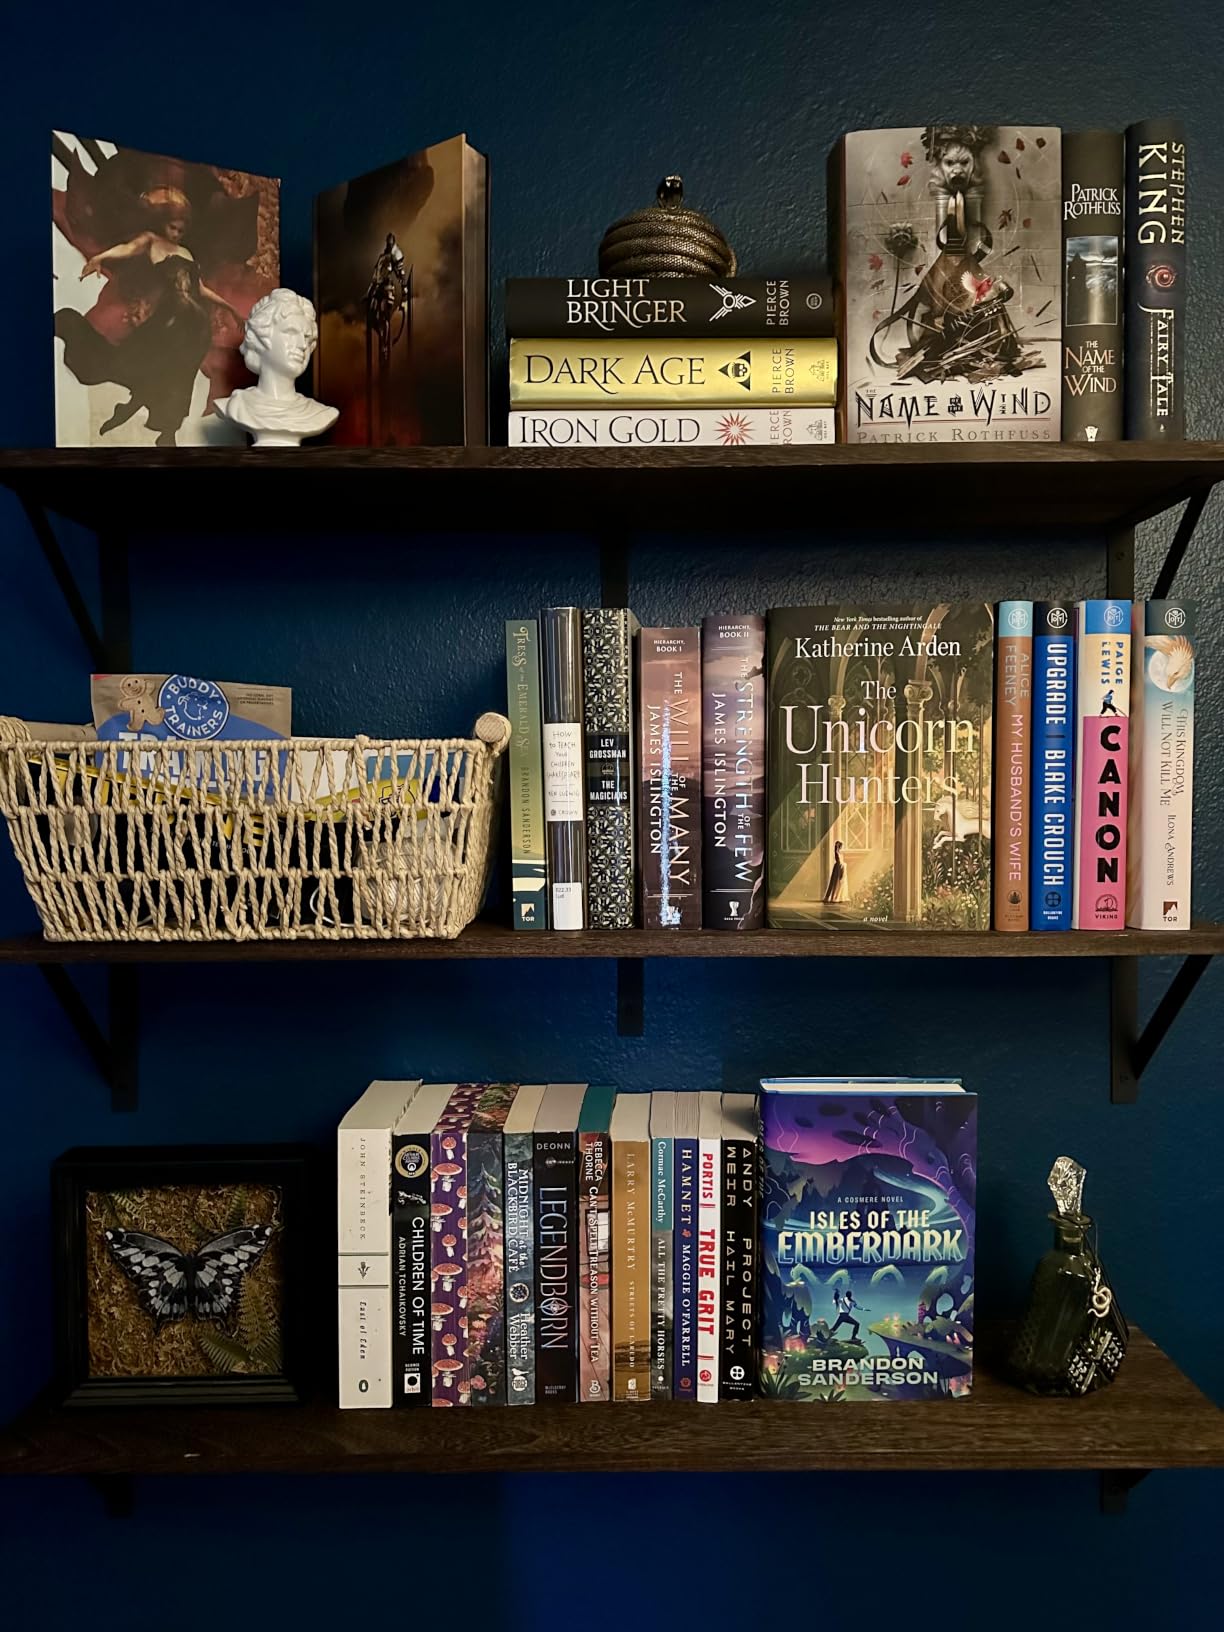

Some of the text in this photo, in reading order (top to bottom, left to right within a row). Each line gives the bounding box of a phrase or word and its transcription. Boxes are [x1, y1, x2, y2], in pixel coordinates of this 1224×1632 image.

[1063, 201, 1121, 220] ROTHFUSS
[1071, 183, 1118, 202] PATRICK
[1138, 142, 1167, 244] KING
[1169, 141, 1185, 245] STEPHEN
[567, 278, 650, 298] LIGHT
[766, 280, 777, 325] PIERCE
[779, 280, 790, 326] BROWN
[566, 300, 687, 331] BRINGER
[1065, 346, 1116, 369] NAME
[1086, 340, 1099, 348] THE
[1137, 302, 1174, 416] FAIRY TALE
[526, 354, 706, 395] DARK AGE
[772, 348, 782, 393] PIERCE
[785, 348, 795, 394] BROWN
[1064, 374, 1117, 397] WIND
[855, 391, 940, 430] NAME
[969, 387, 1051, 426] WIND
[519, 415, 700, 447] IRON GOLD
[857, 428, 1051, 443] PATRICK ROTHFUSS
[719, 631, 740, 639] BOOK
[873, 615, 899, 623] bestselling
[889, 622, 942, 630] NIGHTINGALE
[740, 657, 749, 679] THE
[795, 635, 962, 658] Katherine Arden
[1101, 641, 1110, 685] LEWIS
[1115, 641, 1124, 685] PAIGE
[168, 676, 220, 699] BUDDY
[674, 671, 683, 694] THE
[860, 680, 897, 700] The
[1005, 645, 1017, 707] FEENEY
[1020, 653, 1031, 698] ALICE
[1045, 643, 1068, 725] UPGRADE
[165, 706, 224, 737] TRAINERS
[517, 684, 529, 734] EMERALD
[780, 705, 978, 754] Unicorn
[589, 749, 627, 759] GROSSMAN
[601, 738, 614, 747] LEV
[735, 681, 754, 808] STRENGTH
[1160, 701, 1173, 806] WILL NOT KILL ME
[601, 780, 615, 789] THE
[647, 704, 662, 854] JAMES ISLINGTON
[671, 772, 679, 791] THE
[679, 775, 686, 789] OF
[712, 692, 727, 847] JAMES ISLINGTON
[796, 763, 960, 805] Hunters
[1044, 749, 1066, 804] BLAKE
[520, 767, 532, 854] BRANDON SANDERSON
[590, 791, 628, 800] MAGICIANS
[1009, 714, 1024, 881] MY HUSBAND'S WIFE
[1095, 725, 1122, 883] CANON
[668, 796, 690, 886] MANY
[744, 815, 751, 827] OF
[734, 834, 753, 883] FEW
[1043, 813, 1065, 886] CROUCH
[1164, 814, 1177, 886] ILONA ANDREWS
[536, 1142, 571, 1151] DEONN
[585, 1142, 594, 1181] THORNE
[594, 1141, 603, 1182] REBECCA
[507, 1162, 518, 1236] BLACKBIRD
[518, 1169, 529, 1238] MIDNIGHT
[655, 1141, 667, 1223] Cormac McCarthy
[881, 1195, 904, 1203] NOVEL
[626, 1153, 636, 1270] LARRY McMURTRY
[809, 1209, 931, 1230] ISLES OF THE
[412, 1216, 425, 1291] CHILDREN
[519, 1240, 527, 1250] at
[681, 1149, 692, 1367] HAMNET MAGGIE O'FARRELL
[698, 1153, 716, 1336] PORTIS TRUE GRIT
[725, 1146, 737, 1354] WEIR HAIL MARY
[742, 1147, 753, 1347] ANDY PROJECT
[777, 1229, 966, 1264] EMBERDARK
[539, 1186, 569, 1349] LEGENDBORN
[589, 1250, 599, 1295] TREASON
[412, 1296, 425, 1317] OF
[590, 1297, 600, 1340] WITHOUT
[656, 1238, 666, 1370] ALL THE PRETTY HORSES
[412, 1320, 425, 1355] TIME
[509, 1313, 520, 1360] Webber
[520, 1313, 531, 1360] Heather
[590, 1343, 601, 1362] TEA
[798, 1372, 938, 1386] SANDERSON
[812, 1358, 924, 1372] BRANDON
